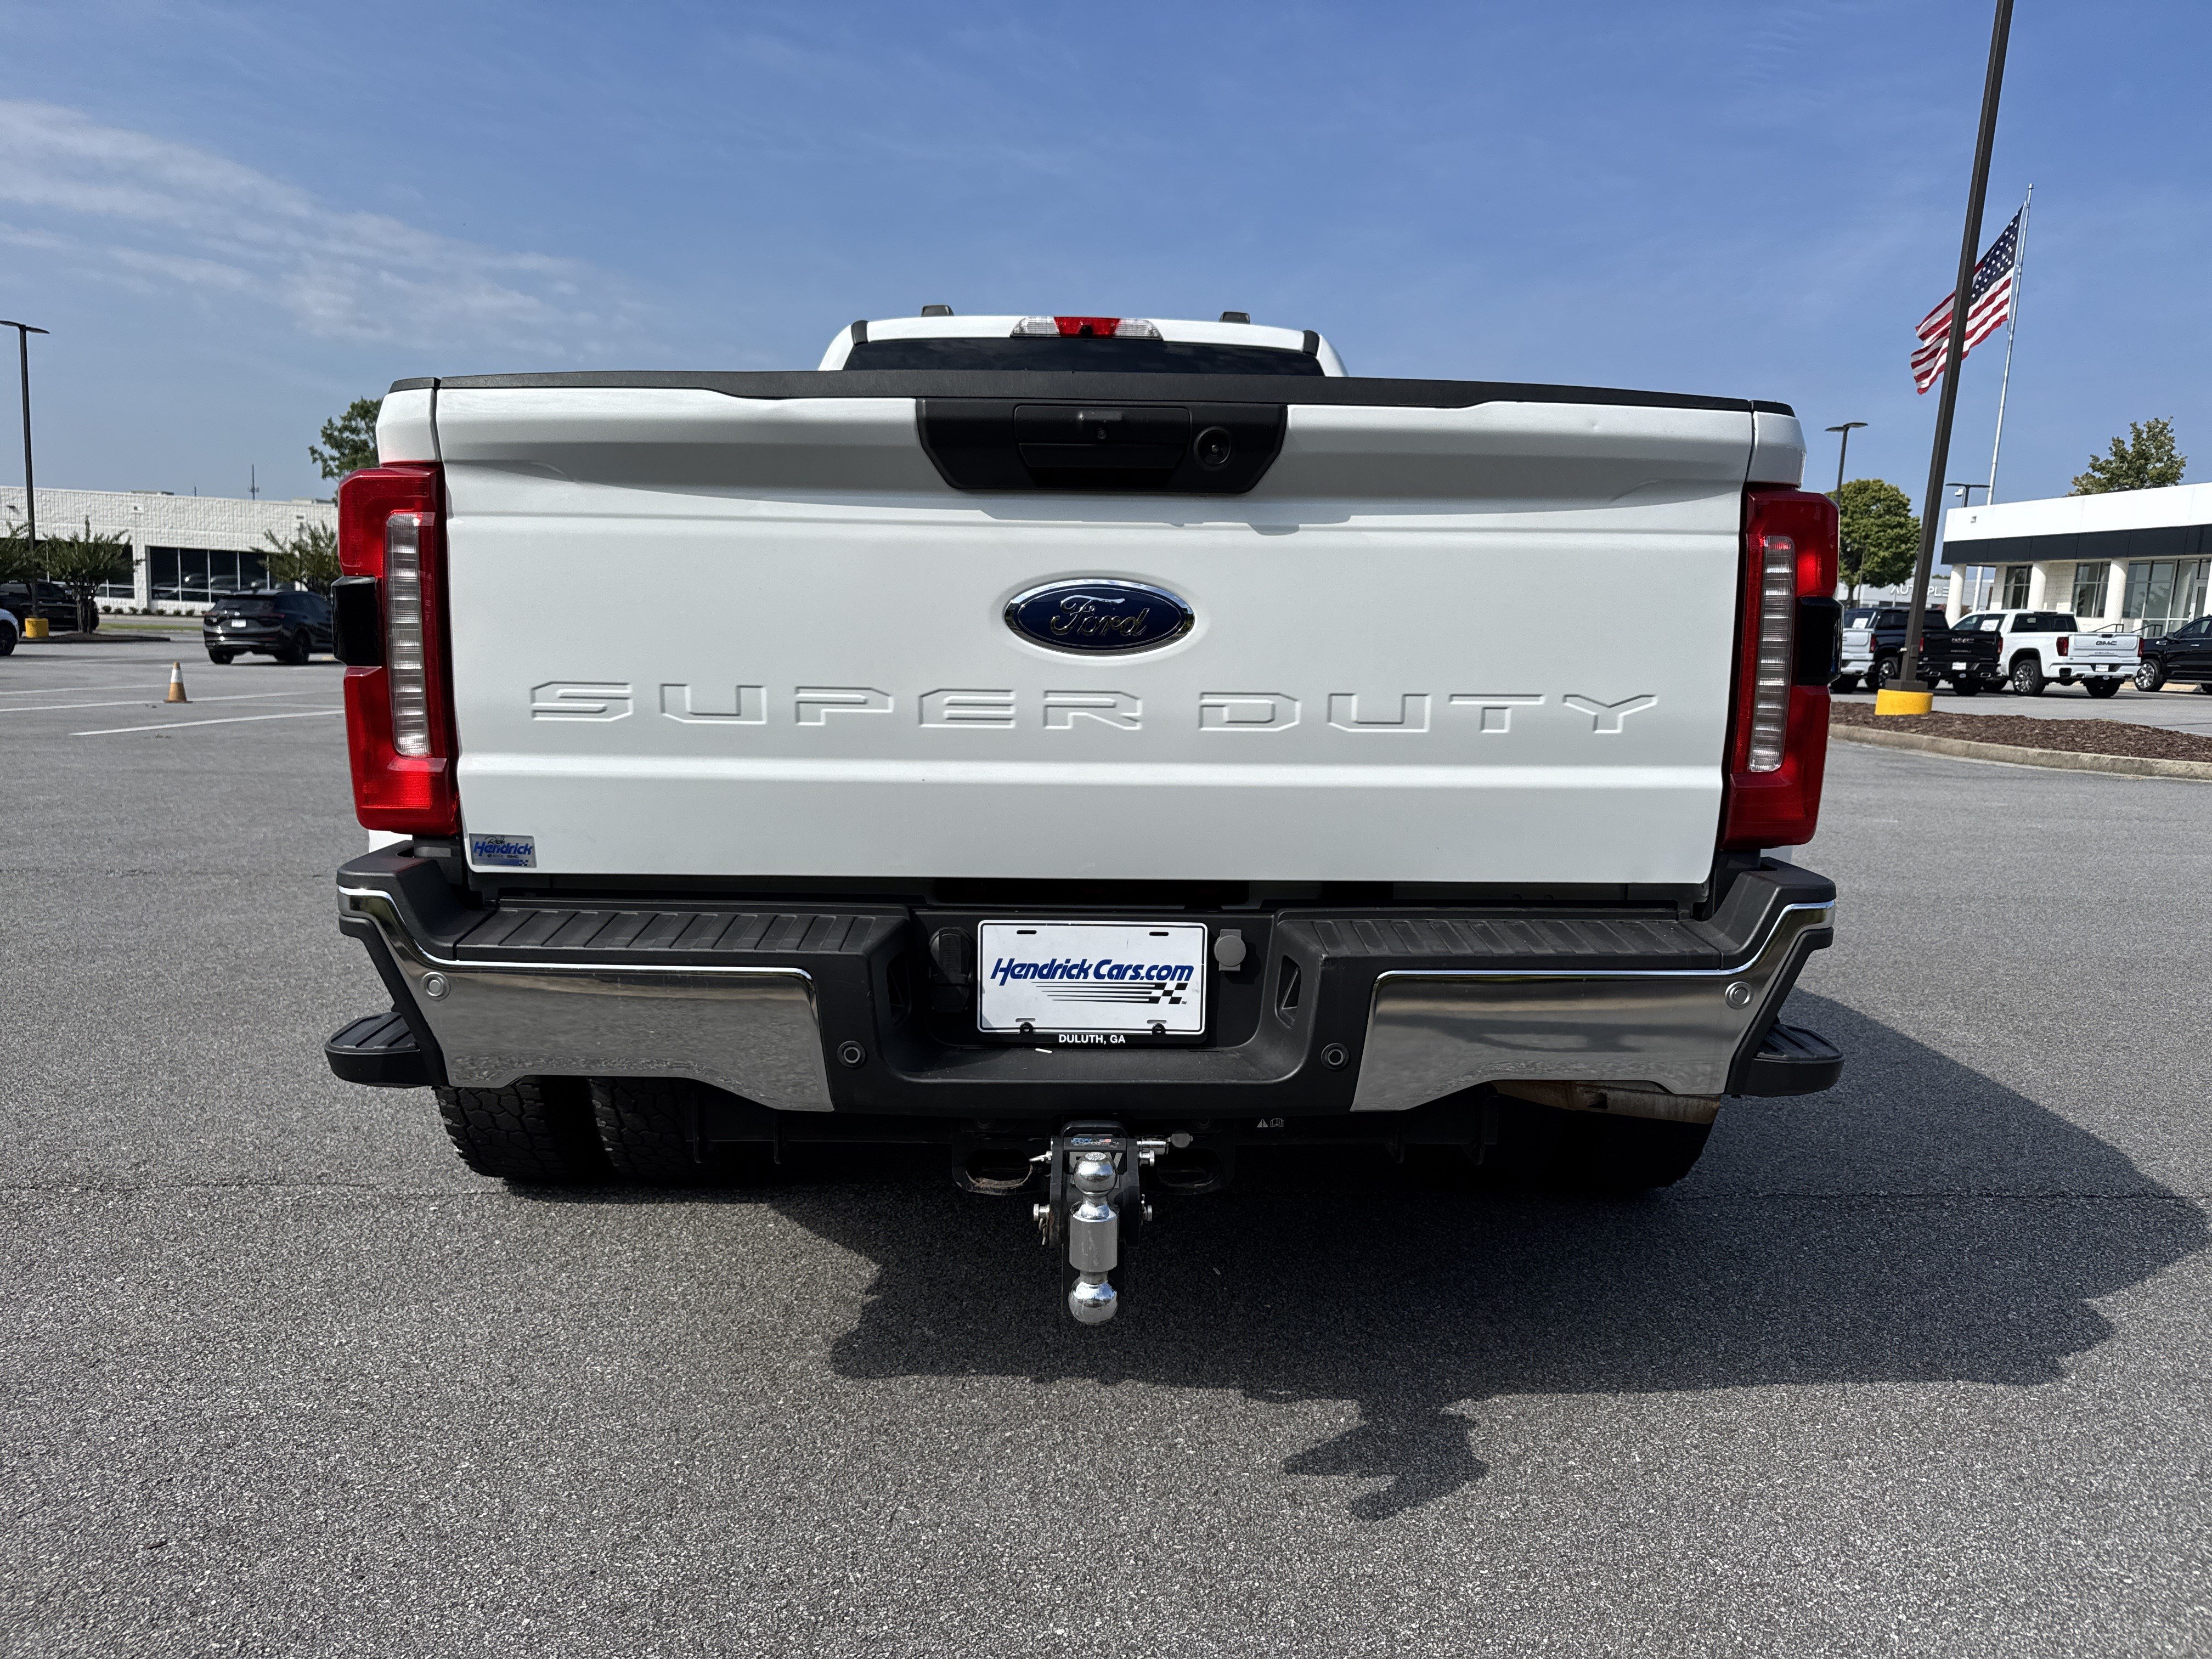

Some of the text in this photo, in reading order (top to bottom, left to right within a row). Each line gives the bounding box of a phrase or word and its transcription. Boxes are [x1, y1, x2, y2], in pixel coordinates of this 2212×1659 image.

[1890, 583, 1950, 597] AUPLE
[1050, 595, 1150, 636] Ford
[530, 681, 1658, 733] SUPER DUTY
[473, 841, 533, 856] Hendrick
[1059, 1034, 1126, 1045] DULUTH, GA
